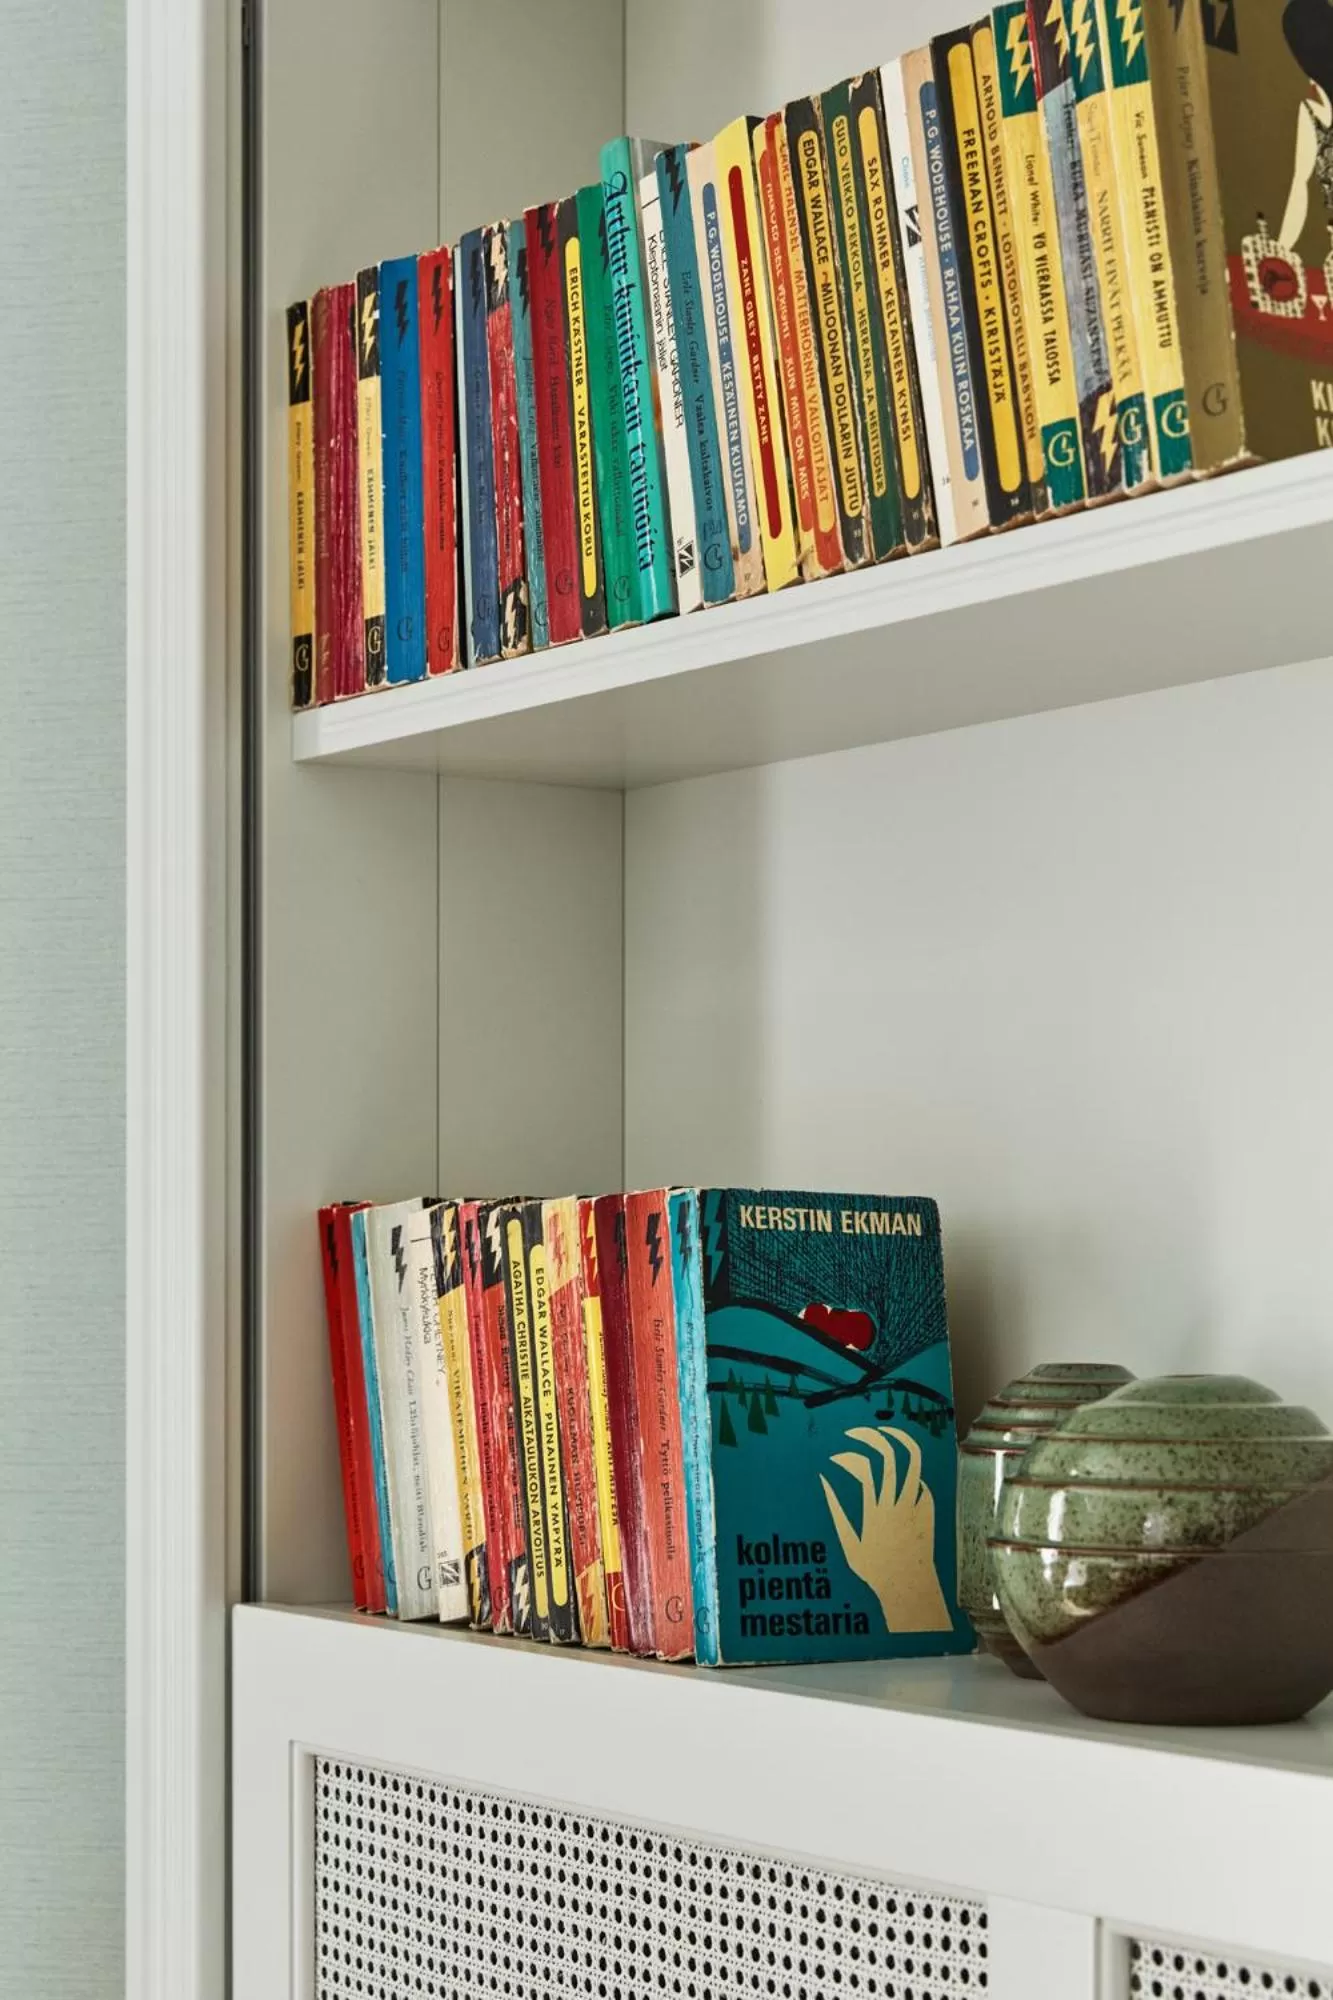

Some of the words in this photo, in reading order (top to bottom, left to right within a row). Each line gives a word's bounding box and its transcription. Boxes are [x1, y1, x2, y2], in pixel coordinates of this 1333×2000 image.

[802, 138, 818, 191] EDGAR
[834, 117, 848, 157] SULO
[840, 161, 855, 219] VEIKKO
[867, 156, 880, 193] SAX
[928, 144, 953, 252] WODEHOUSE
[808, 193, 827, 264] WALLACE
[872, 196, 889, 271] ROHMER
[1141, 185, 1161, 247] PIANISTI
[647, 233, 664, 334] Kleptomaanin
[739, 256, 751, 296] ZANE
[846, 223, 862, 292] PEKKOLA
[961, 128, 983, 215] FREEMAN
[972, 220, 992, 289] CROFTS
[983, 306, 1006, 404] KIRISTÄJÄ
[981, 74, 998, 141] ARNOLD
[990, 145, 1007, 216] BENNETT
[1001, 232, 1024, 358] LOISTOHOTELLI
[1018, 362, 1037, 440] BABYLON
[1148, 251, 1164, 273] ON
[568, 266, 579, 313] ERICH
[709, 244, 728, 346] WODEHOUSE
[744, 300, 755, 337] GREY
[942, 267, 962, 328] RAHAA
[1034, 254, 1054, 325] VIERAASSA
[1151, 278, 1173, 349] AMMUTTU
[820, 280, 841, 377] MILJOONAN
[856, 308, 873, 379] HERRANA
[885, 288, 904, 384] KELTAINEN
[951, 331, 968, 376] KUIN
[1043, 329, 1061, 386] TALOSSA
[721, 361, 739, 441] KESÄINEN
[750, 353, 763, 400] BETTY
[794, 269, 815, 389] MATTERHORNIN
[807, 394, 828, 504] VALLOITTAJAT
[864, 386, 875, 405] JA
[757, 405, 769, 446] ZANE
[832, 382, 853, 460] DOLLARIN
[897, 387, 912, 443] KYNSI
[957, 379, 975, 451] ROSKAA
[577, 406, 591, 509] VARASTETTU
[793, 435, 805, 462] ON
[628, 441, 659, 573] tarinoita
[729, 446, 746, 527] KUUTAMO
[842, 464, 860, 512] JUTTU
[582, 511, 594, 557] KORU
[740, 1205, 832, 1233] KERSTIN
[841, 1209, 923, 1237] EKMAN
[512, 1259, 524, 1316] AGATHA
[535, 1266, 547, 1318] EDGAR
[516, 1319, 530, 1380] CHRISTIE
[538, 1325, 551, 1397] WALLACE
[522, 1394, 539, 1503] AIKATAULUKON
[544, 1410, 558, 1495] PUNAINEN
[531, 1507, 545, 1578] ARVOITUS
[550, 1500, 563, 1568] YMPYRÄ
[737, 1535, 827, 1566] kolme
[739, 1569, 831, 1607] pientä
[740, 1604, 869, 1637] mestaria
